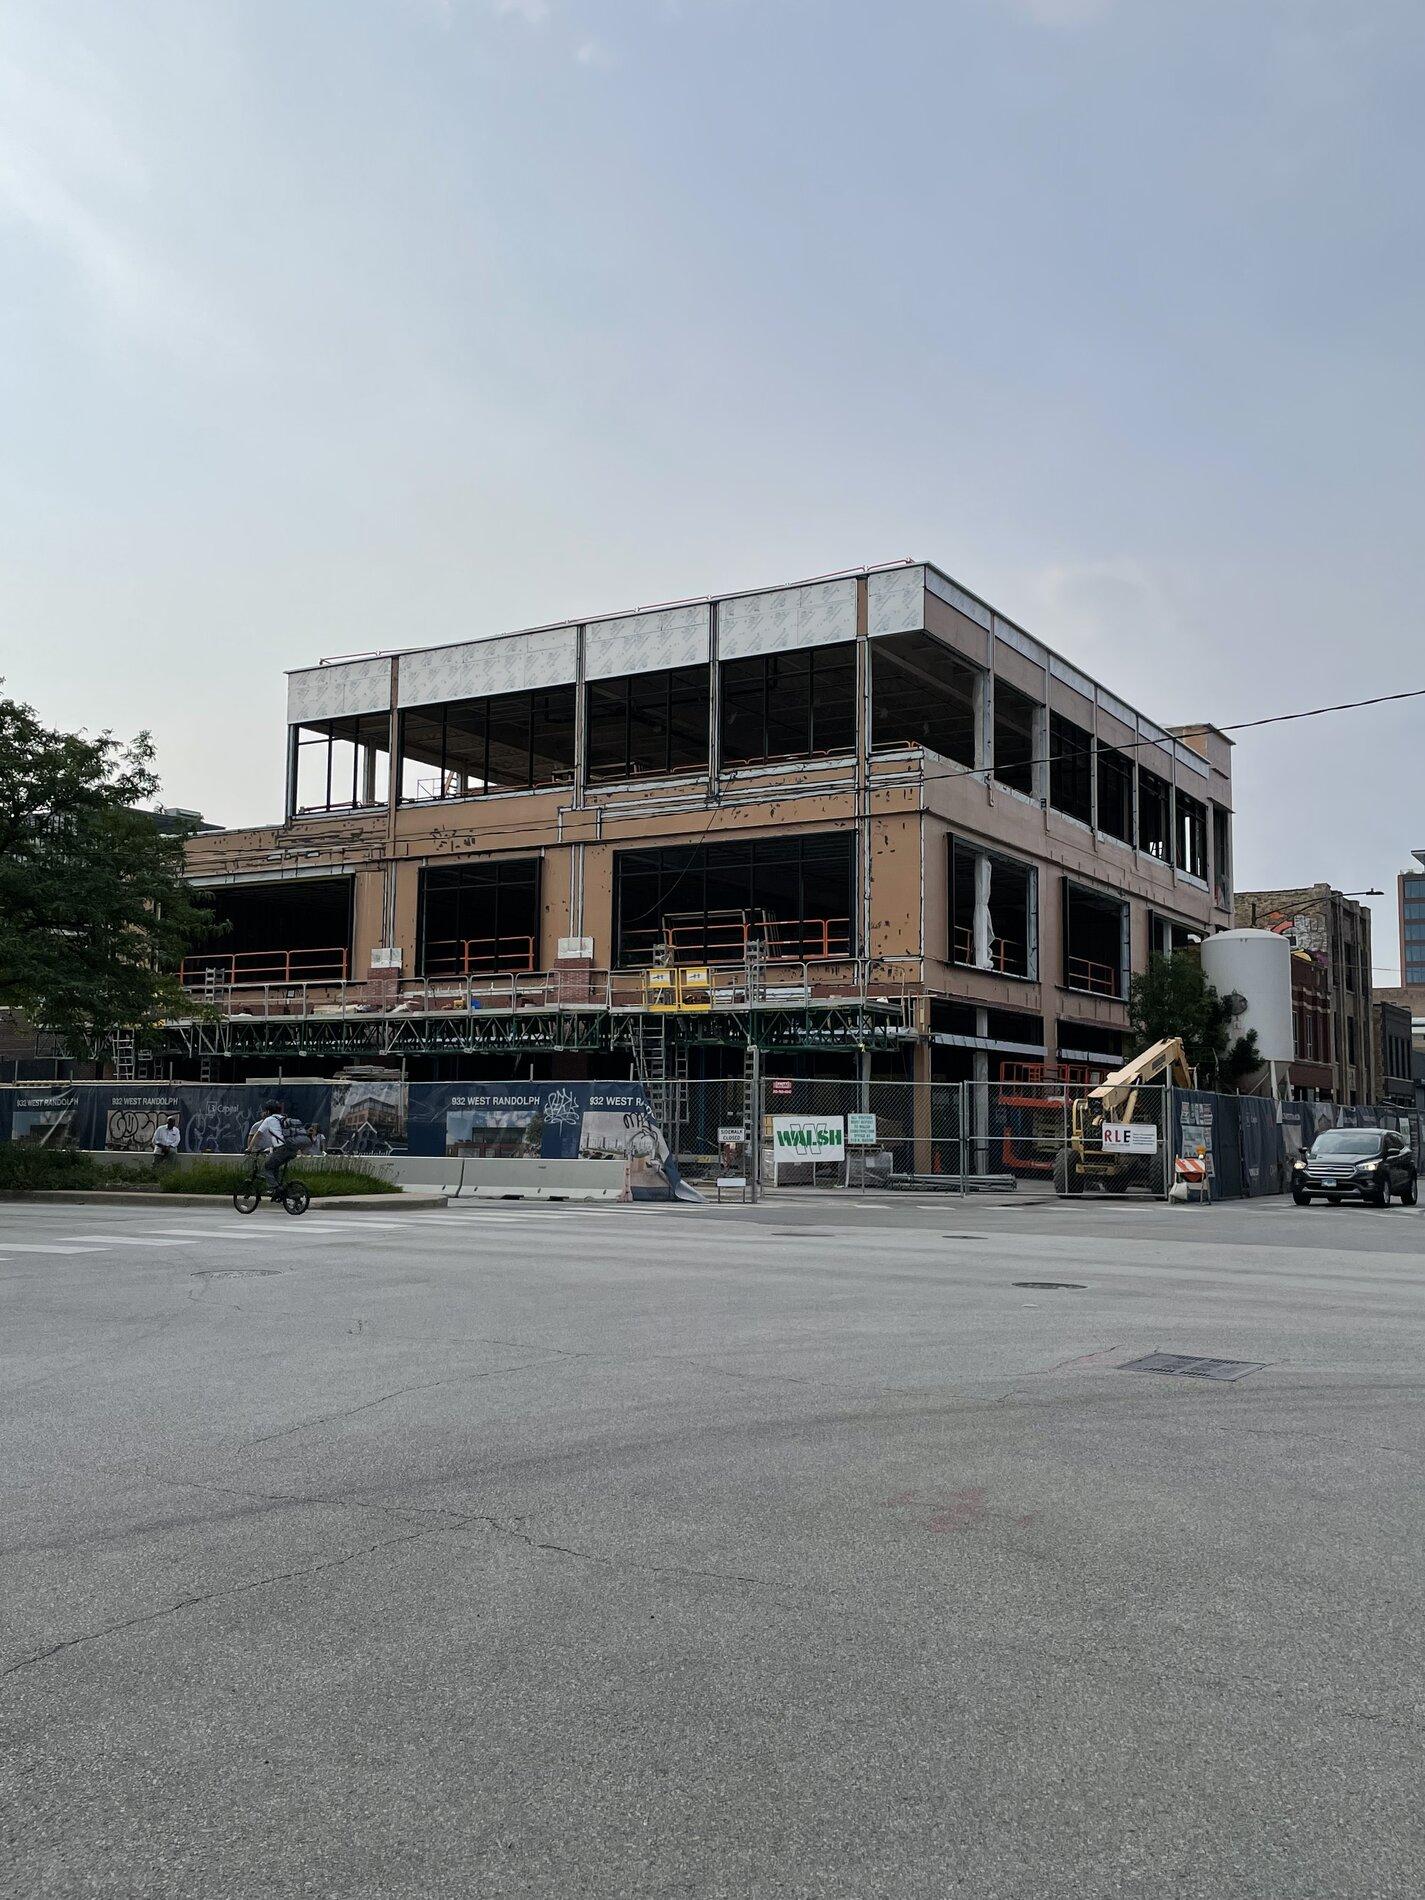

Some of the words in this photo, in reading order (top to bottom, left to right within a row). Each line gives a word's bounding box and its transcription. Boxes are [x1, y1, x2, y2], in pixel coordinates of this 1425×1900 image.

[27, 1099, 44, 1107] WEST
[44, 1098, 79, 1107] RANDOLPH
[111, 1097, 122, 1105] 932
[123, 1097, 141, 1105] WEST
[142, 1097, 178, 1105] RANDOLPH
[451, 1097, 466, 1106] 932
[467, 1097, 491, 1105] WEST
[492, 1096, 540, 1105] RANDOLPH
[589, 1096, 604, 1105] 932
[606, 1096, 633, 1106] WEST
[776, 1129, 842, 1147] WALSH
[1104, 1129, 1131, 1143] RLE
